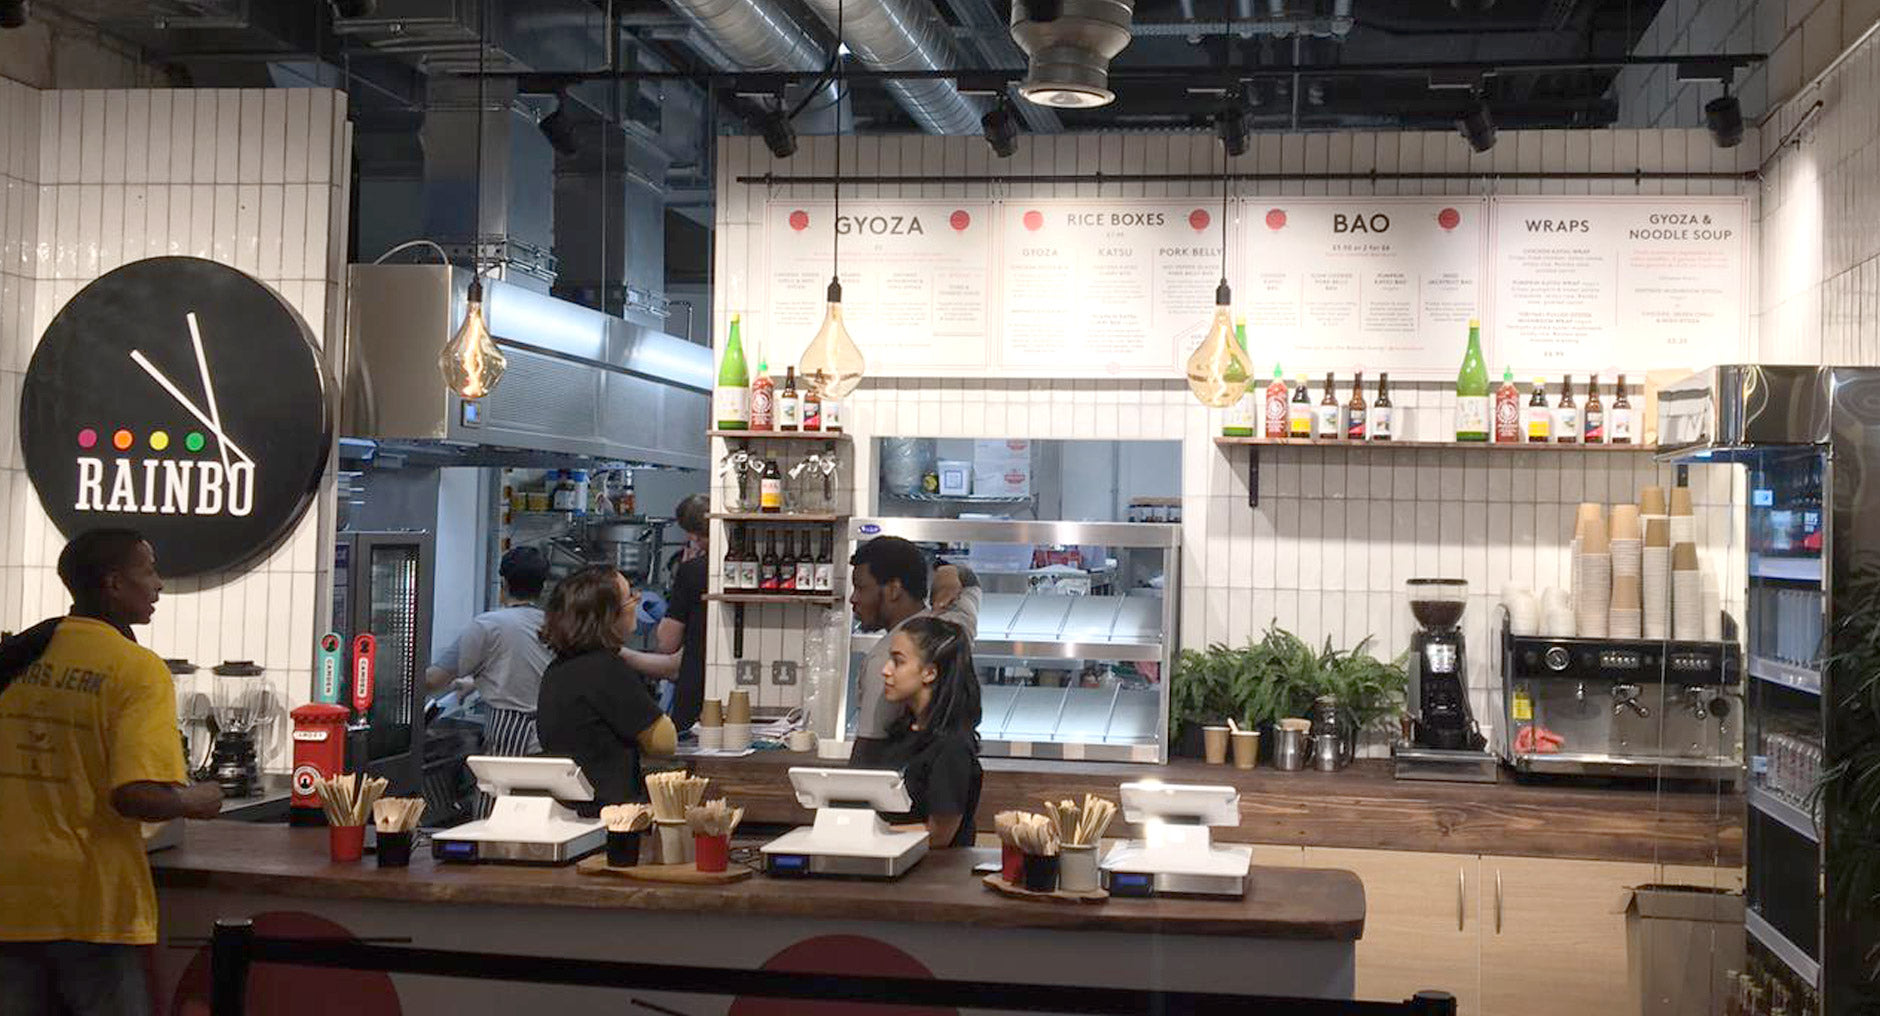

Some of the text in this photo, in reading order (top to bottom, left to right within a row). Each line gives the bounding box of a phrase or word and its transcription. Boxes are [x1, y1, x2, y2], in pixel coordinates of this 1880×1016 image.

[1067, 213, 1165, 226] RICE BOXES
[1333, 213, 1390, 233] BAO
[1649, 213, 1712, 225] GYOZA &
[836, 216, 924, 235] GYOZA
[1525, 219, 1590, 233] WRAPS
[1629, 229, 1733, 240] NOODLE SOUP
[1022, 248, 1058, 257] GYOZA
[1098, 248, 1133, 257] KATSU
[1159, 247, 1222, 257] PORK BELLY
[74, 456, 256, 517] RAINBO
